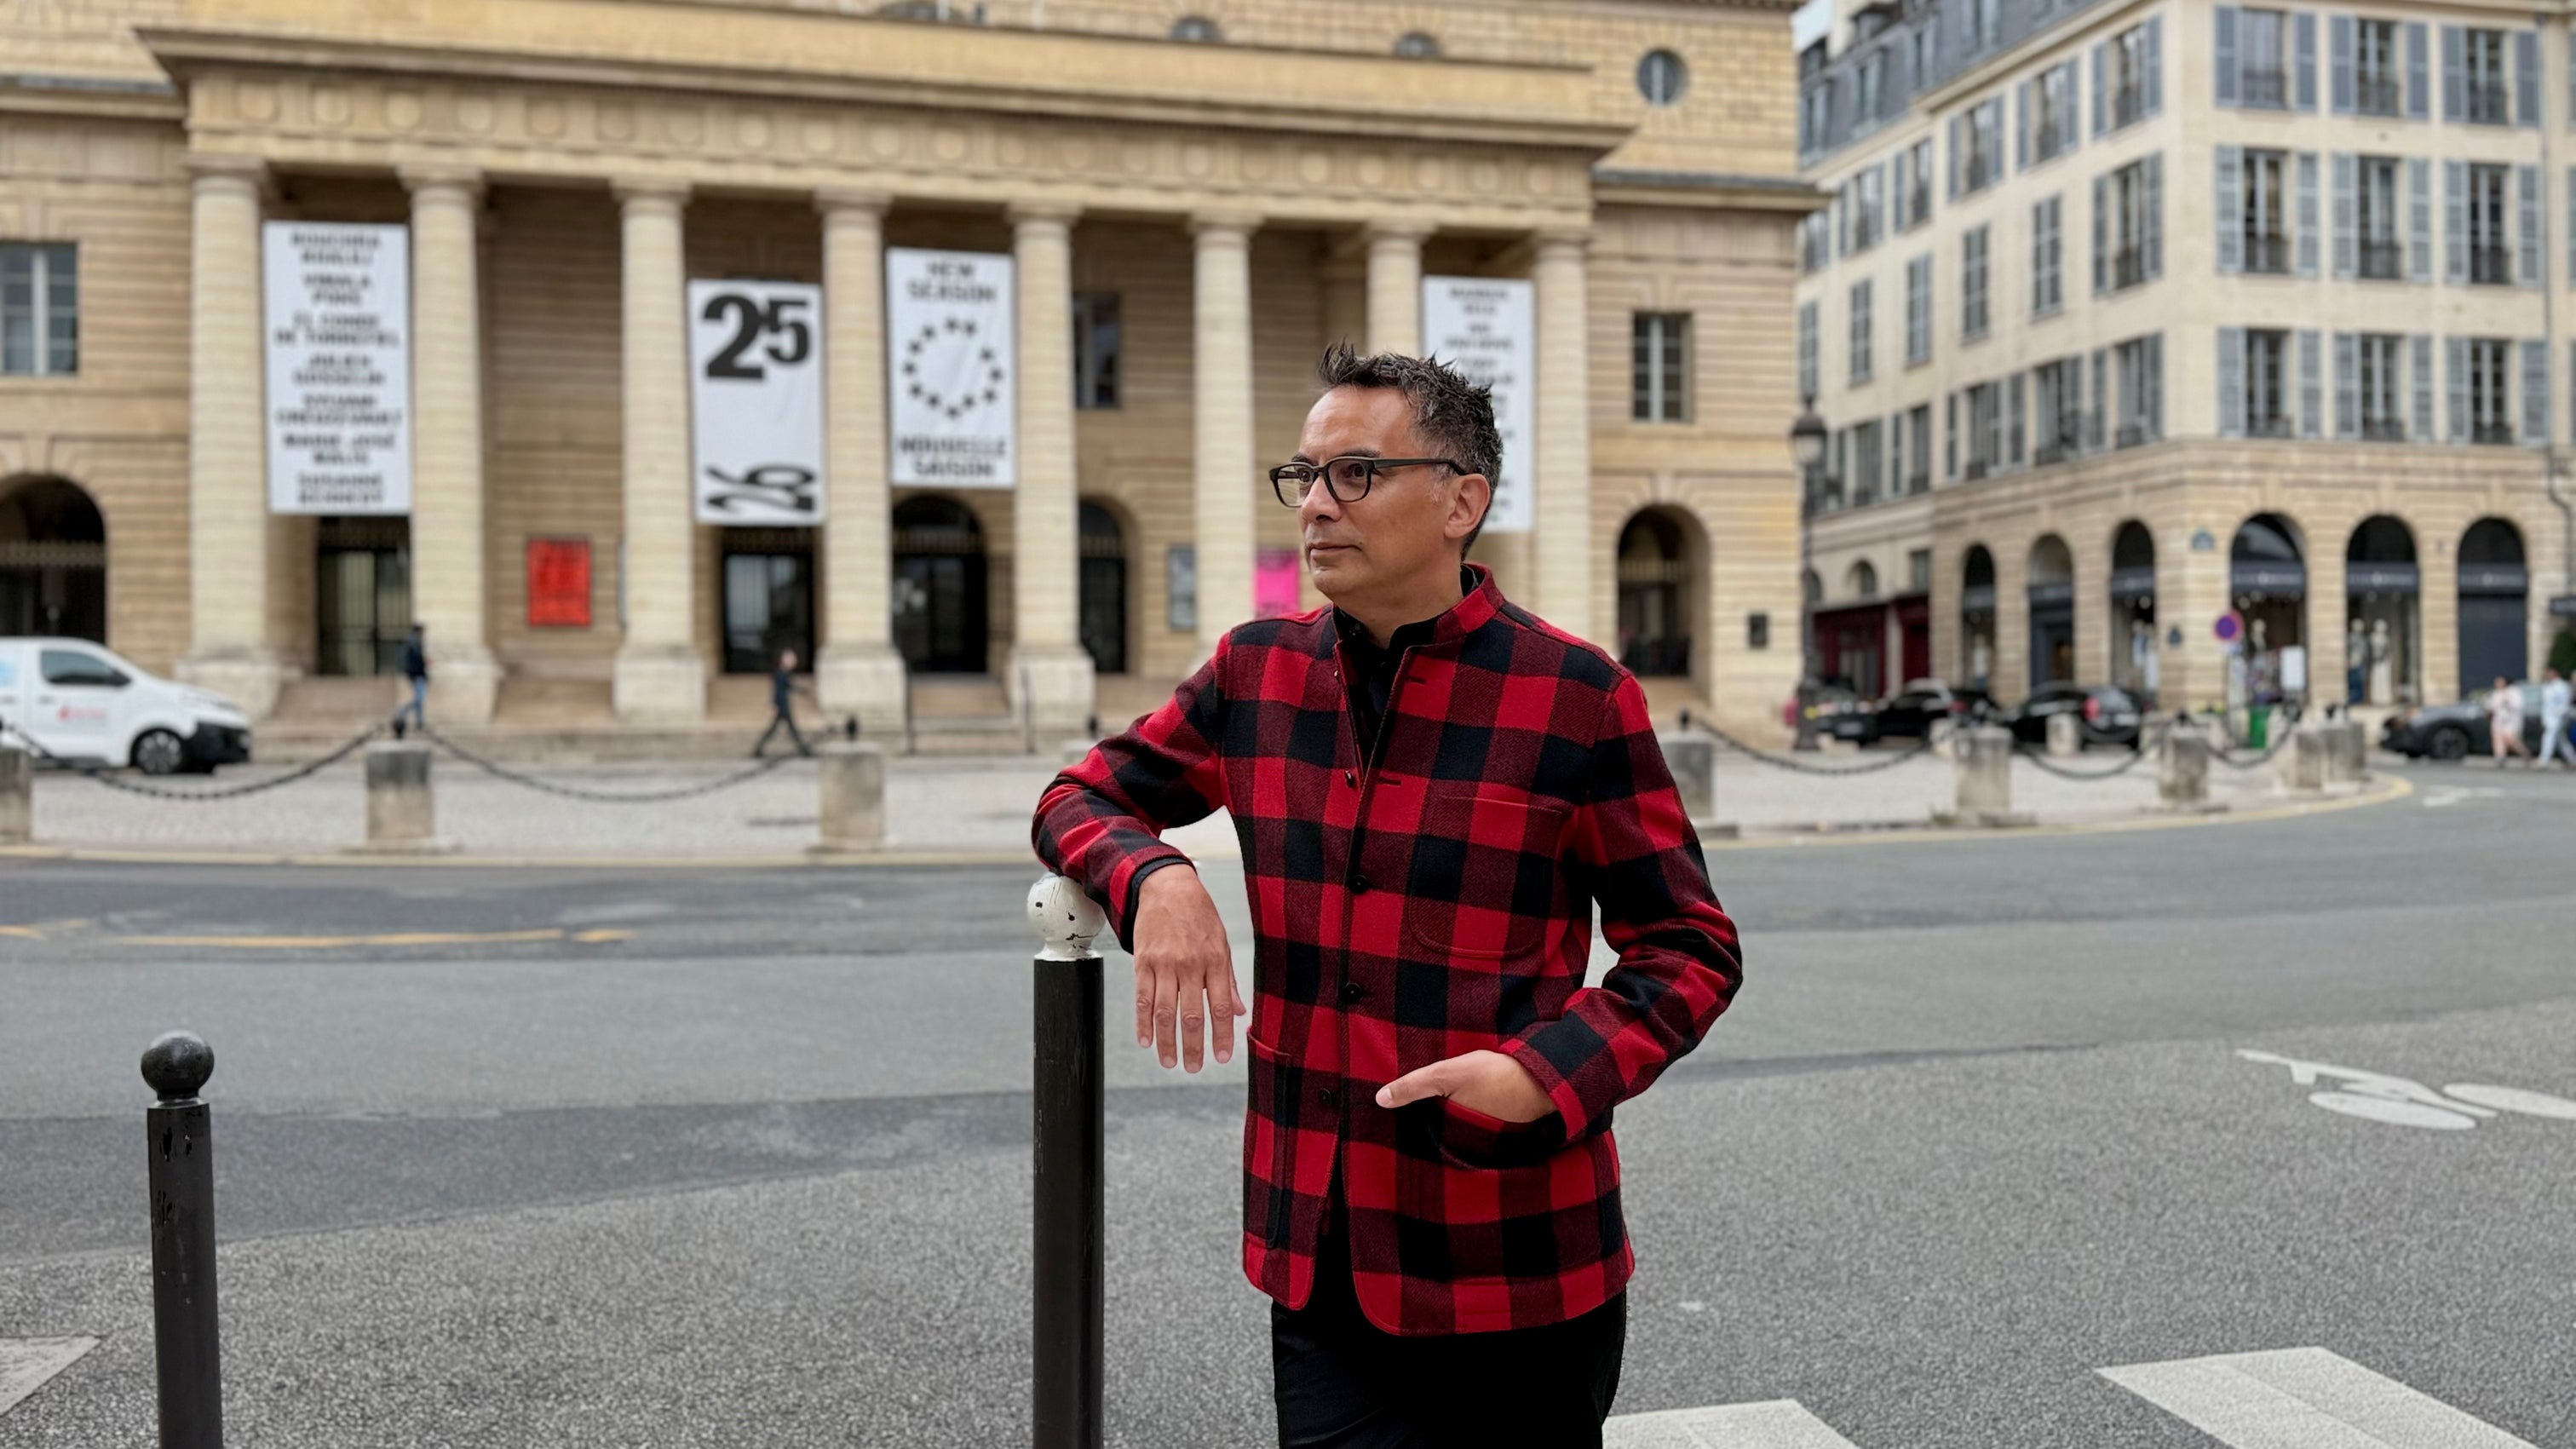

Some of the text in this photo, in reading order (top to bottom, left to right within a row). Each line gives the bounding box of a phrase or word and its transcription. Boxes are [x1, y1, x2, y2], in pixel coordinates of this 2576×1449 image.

[927, 262, 975, 278] NEW
[908, 282, 997, 302] SEASON
[703, 294, 812, 380] 25
[898, 436, 1006, 457] NOUVELLE
[913, 461, 994, 478] SAISON
